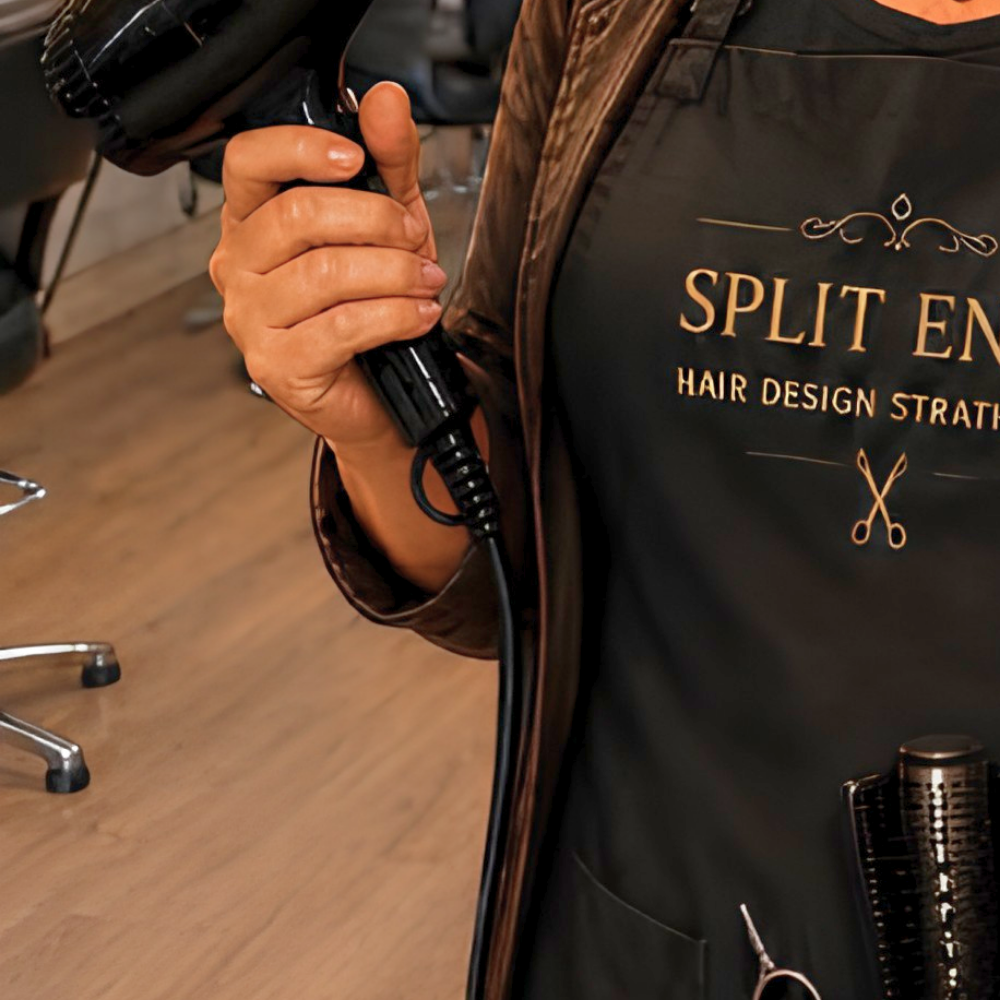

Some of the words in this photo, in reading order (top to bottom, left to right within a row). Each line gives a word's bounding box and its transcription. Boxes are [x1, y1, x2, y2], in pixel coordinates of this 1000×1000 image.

[679, 267, 886, 353] SPLIT
[677, 367, 748, 403] HAIR
[762, 377, 876, 418] DESIGN
